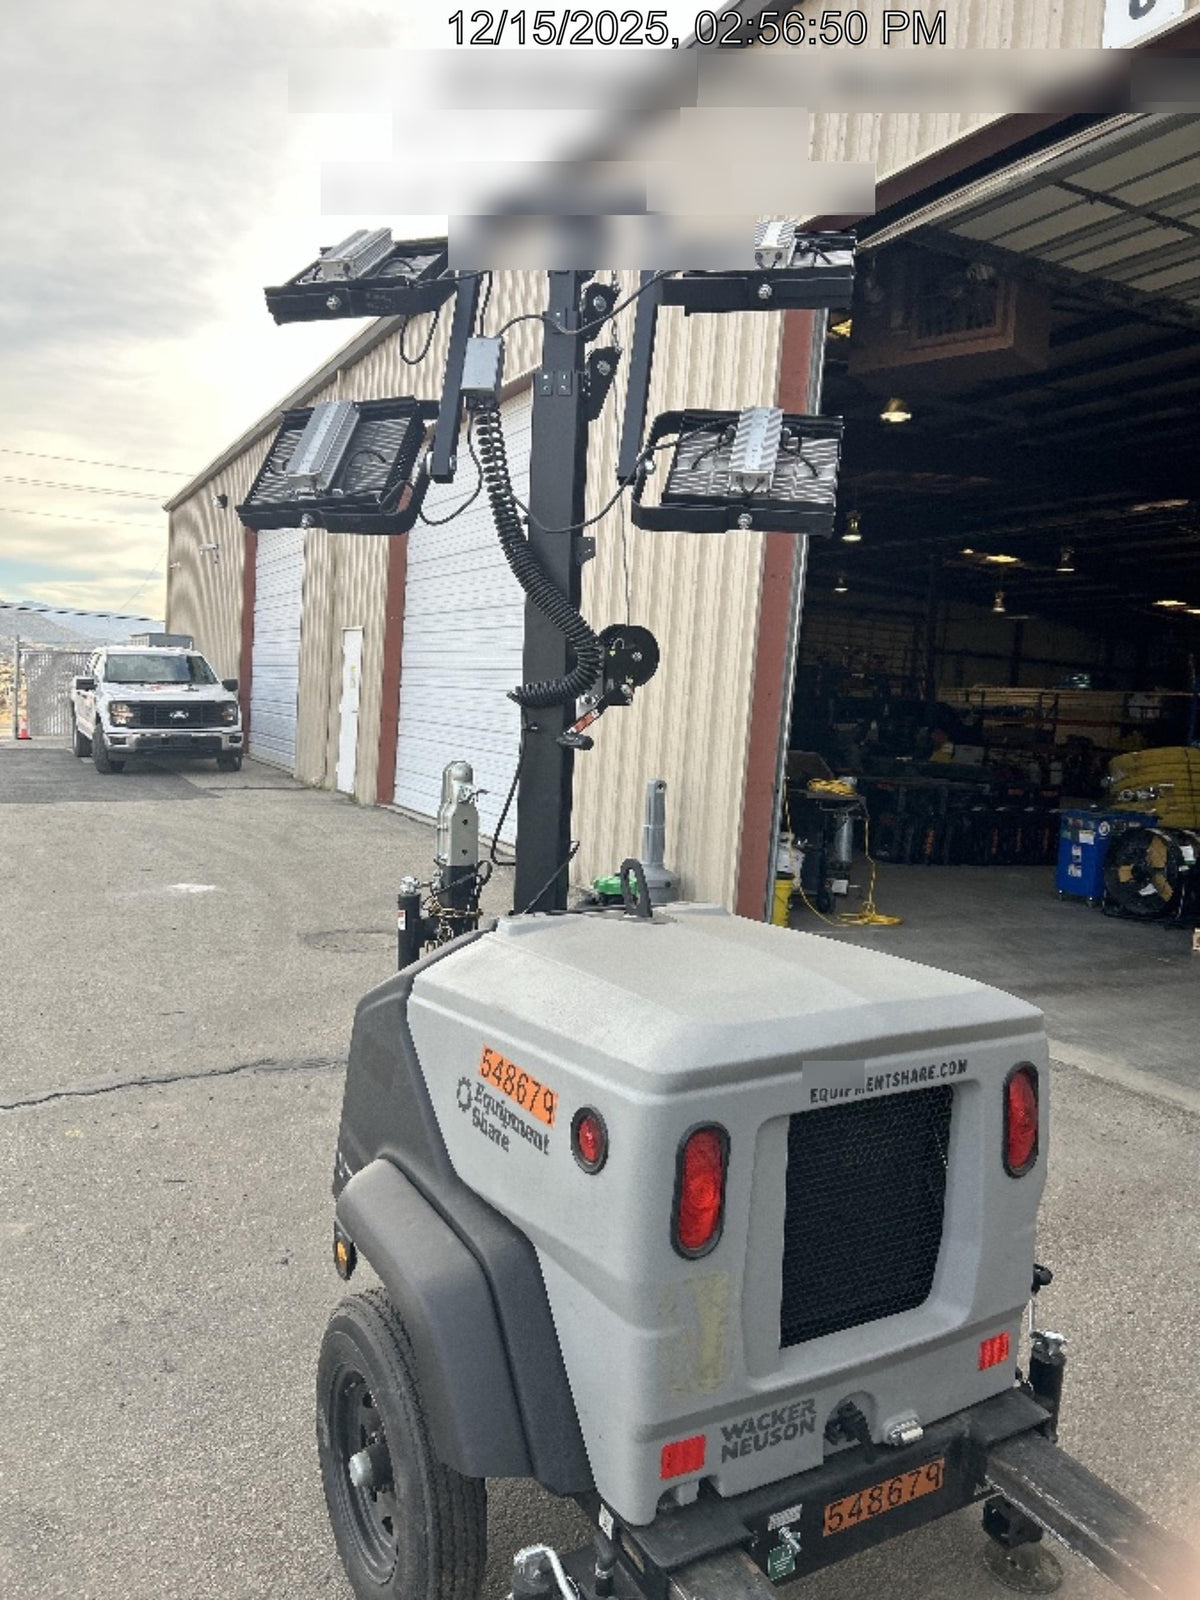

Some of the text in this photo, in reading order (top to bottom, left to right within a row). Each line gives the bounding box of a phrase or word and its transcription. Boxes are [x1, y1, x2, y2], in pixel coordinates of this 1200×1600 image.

[481, 1047, 556, 1125] 548679
[472, 1106, 510, 1152] Share
[474, 1081, 550, 1155] Equipment
[720, 1398, 817, 1442] WACKER
[721, 1414, 817, 1464] NEUSON
[828, 1461, 942, 1533] 548679
